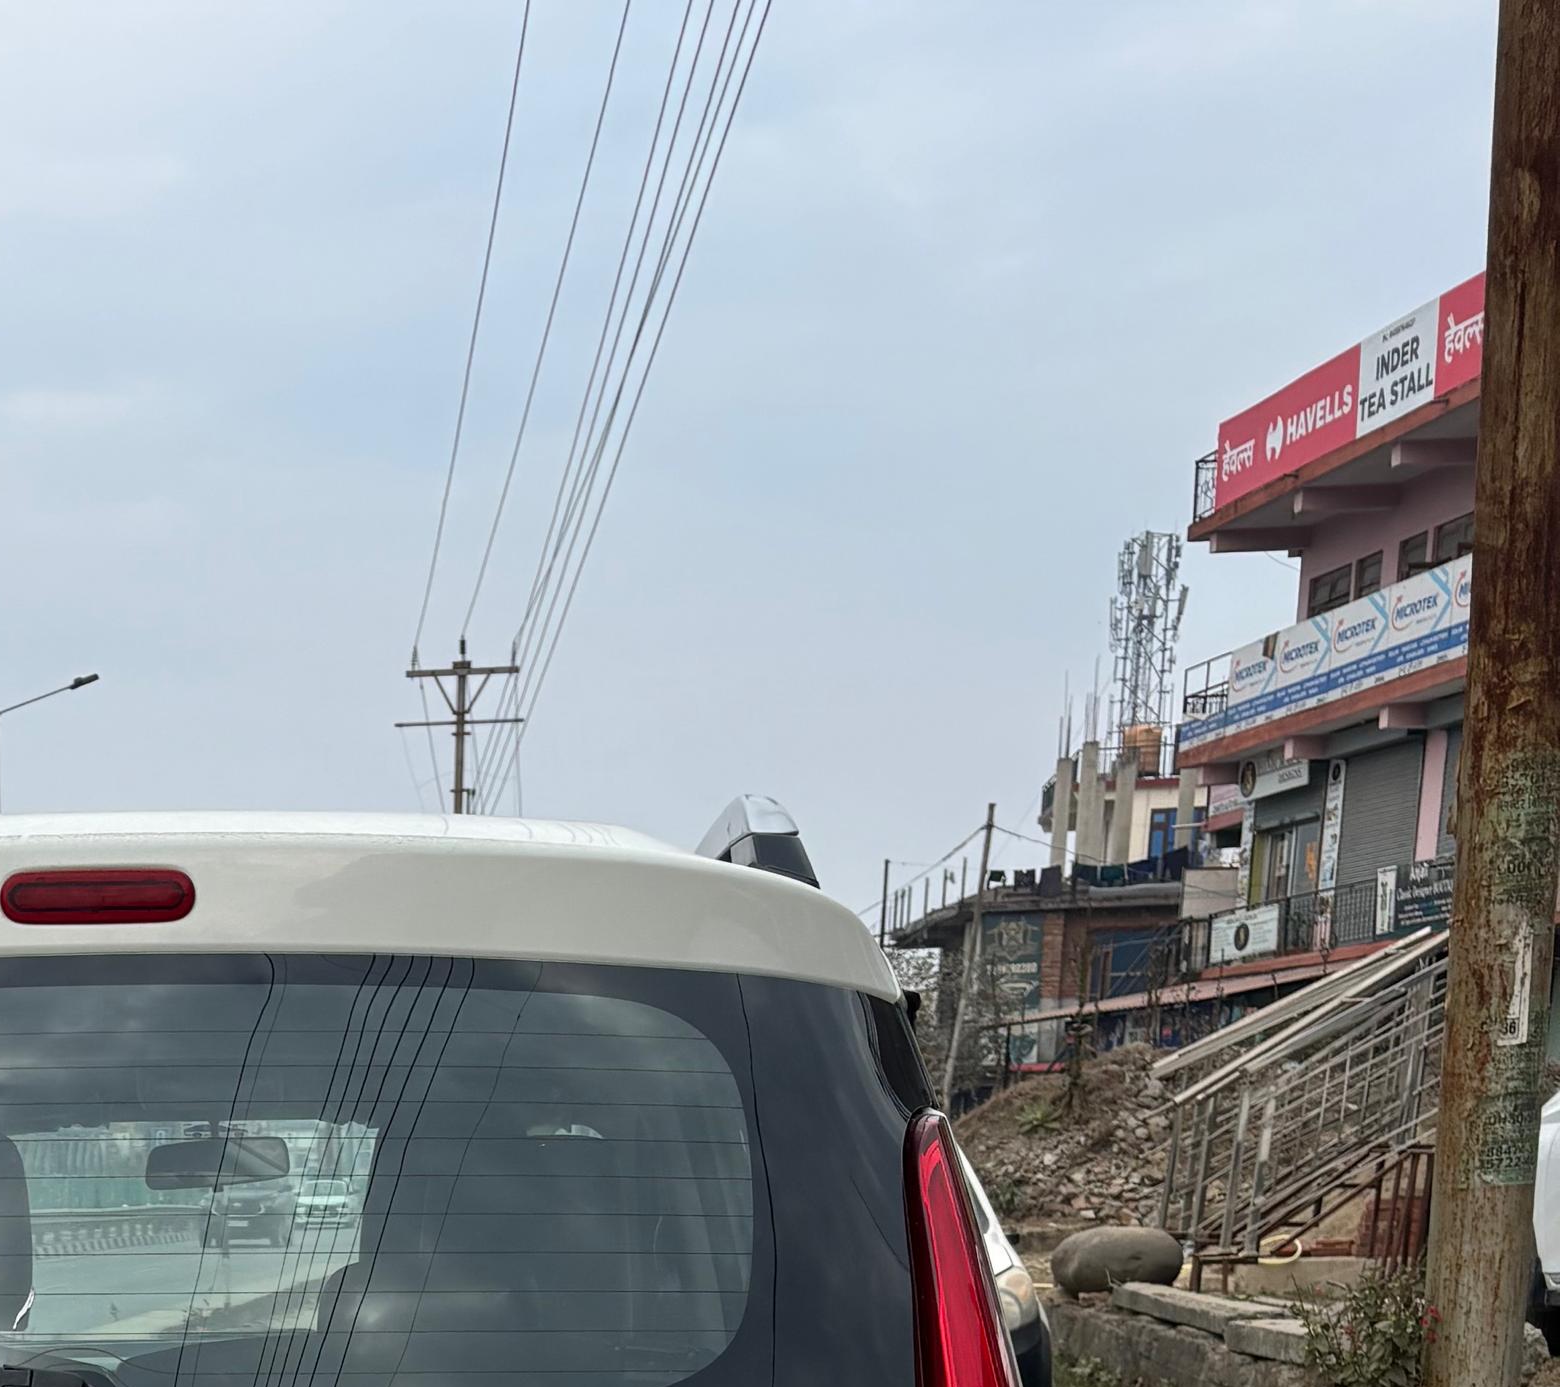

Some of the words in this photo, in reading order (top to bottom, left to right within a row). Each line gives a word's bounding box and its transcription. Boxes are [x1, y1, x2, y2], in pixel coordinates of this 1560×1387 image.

[1376, 335, 1420, 381] INDER
[1360, 387, 1386, 422] TEA
[1390, 362, 1433, 406] STALL
[1286, 384, 1352, 445] HAVELLS
[1222, 438, 1255, 481] हेवल्स
[1395, 595, 1439, 622] MICROTEK
[1283, 640, 1320, 664] MICROTEK
[1336, 618, 1377, 643] MICROTEK
